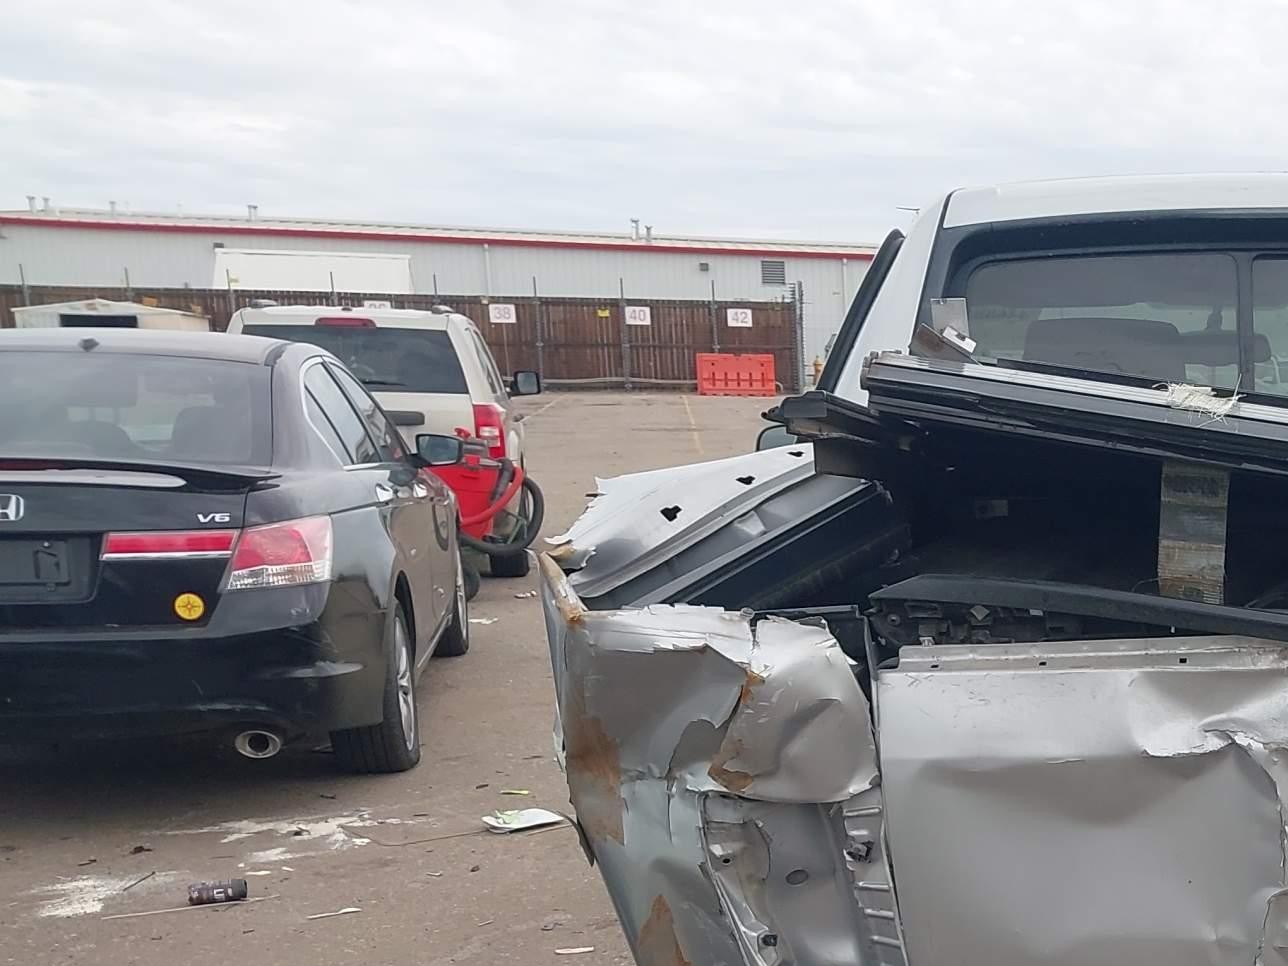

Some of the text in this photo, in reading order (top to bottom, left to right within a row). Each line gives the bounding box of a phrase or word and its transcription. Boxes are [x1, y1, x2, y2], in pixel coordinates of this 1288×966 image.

[493, 307, 511, 320] 38
[628, 309, 647, 322] 40
[731, 311, 749, 324] 42
[196, 512, 231, 523] V6
